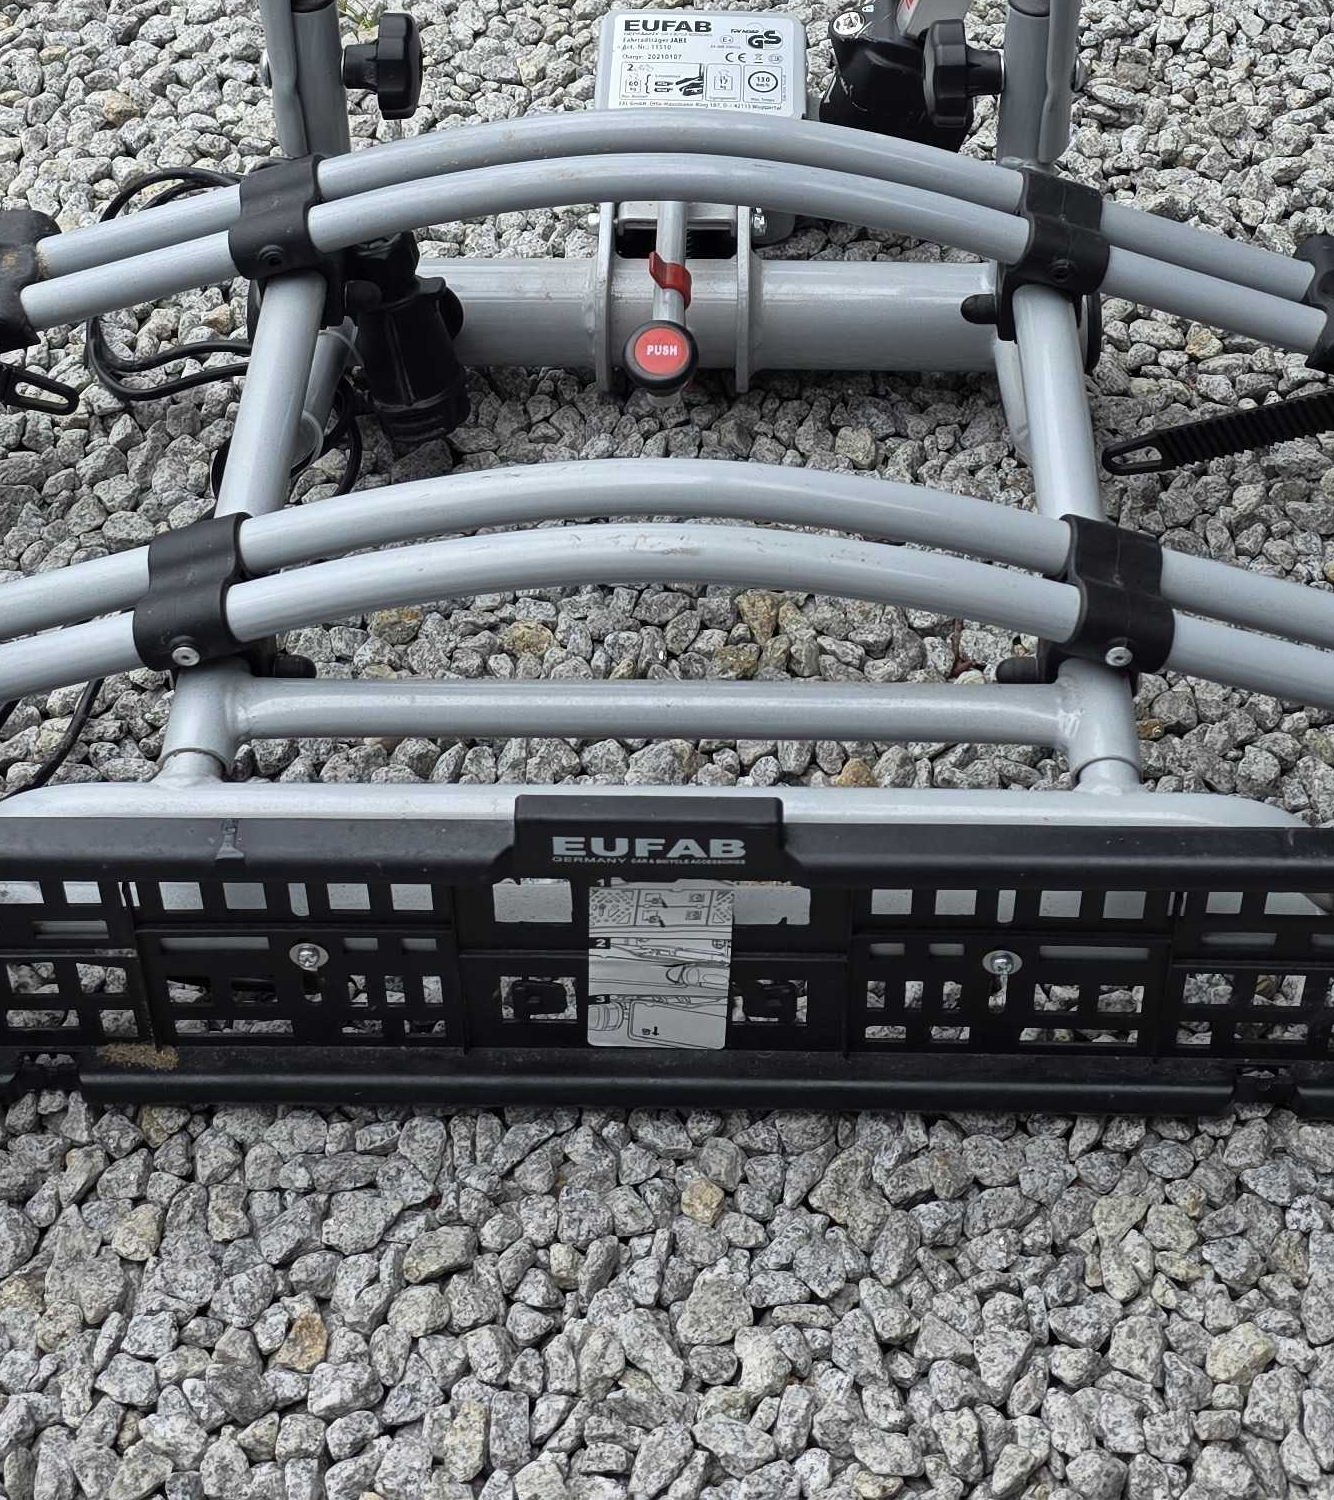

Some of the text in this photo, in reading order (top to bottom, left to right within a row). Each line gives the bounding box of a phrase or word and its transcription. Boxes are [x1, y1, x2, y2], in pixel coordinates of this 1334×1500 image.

[624, 20, 712, 32] EUFAB
[747, 30, 782, 49] GS
[725, 52, 747, 63] CE
[646, 345, 678, 357] PUSH
[552, 836, 746, 858] EUFAB
[595, 939, 607, 947] 2
